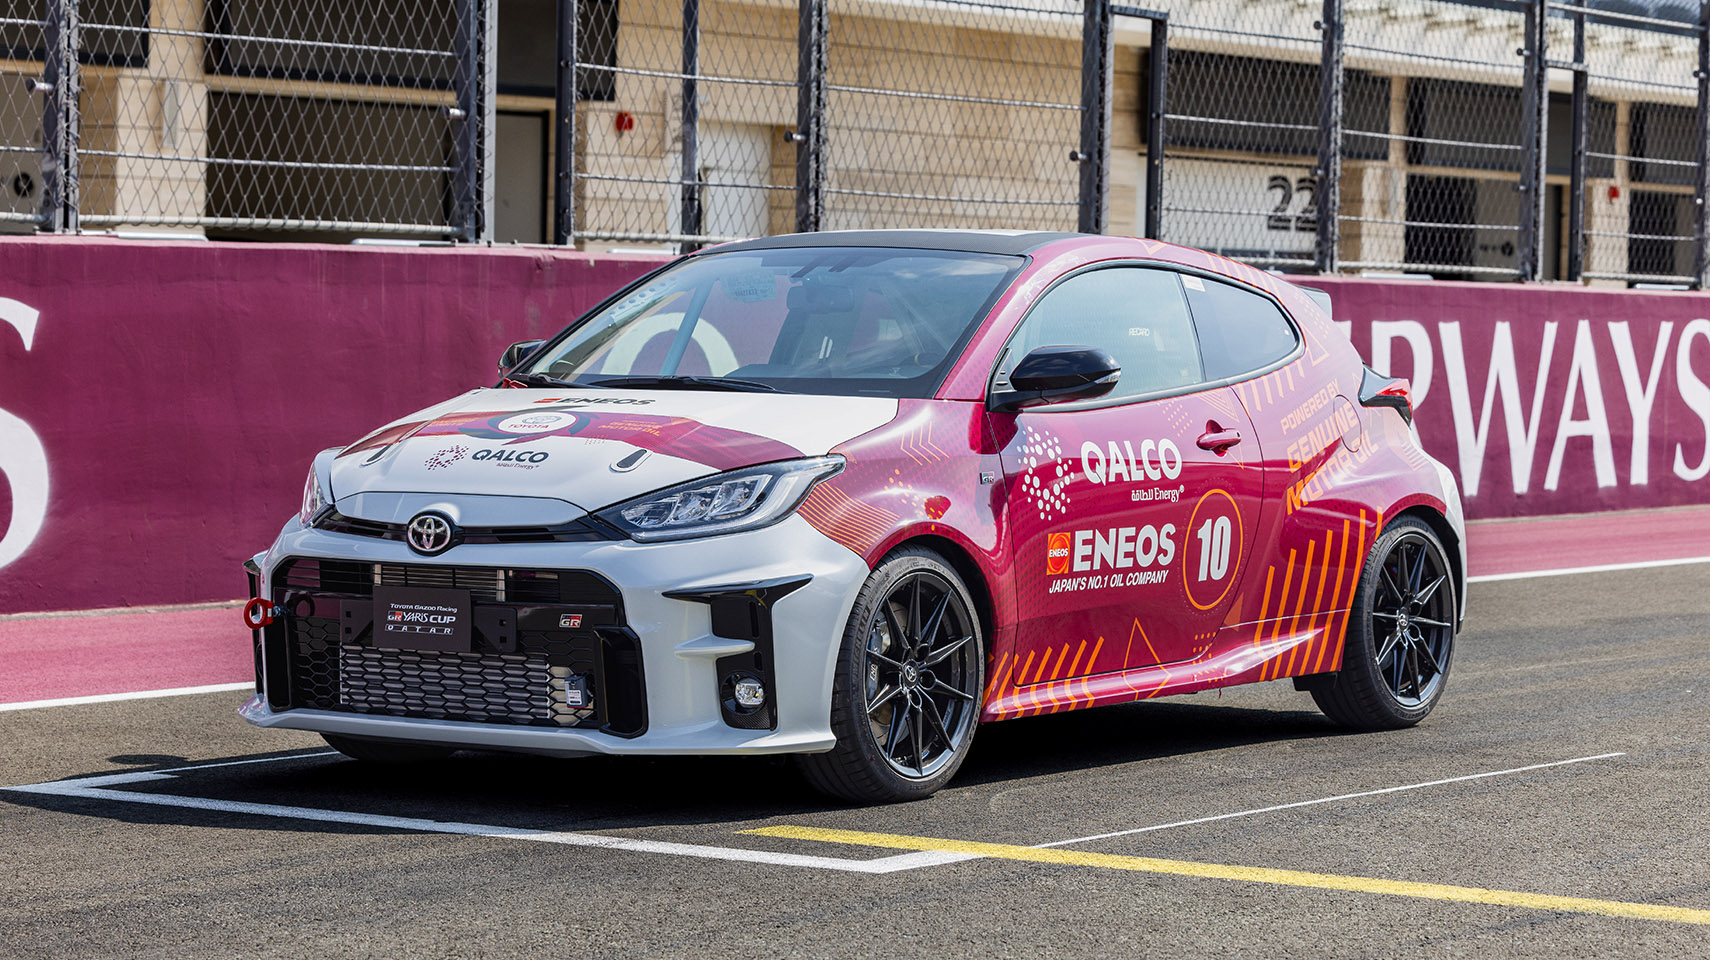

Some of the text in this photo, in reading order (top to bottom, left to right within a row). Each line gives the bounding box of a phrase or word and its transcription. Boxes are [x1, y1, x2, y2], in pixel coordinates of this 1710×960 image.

[1267, 176, 1317, 232] 22
[557, 397, 656, 405] ENEOS
[1280, 378, 1341, 435] POWERED BY
[1337, 319, 1710, 497] RWAYS
[471, 449, 549, 463] QALCO
[1286, 400, 1358, 473] GENUINE
[1080, 438, 1183, 486] QALCO
[1286, 430, 1379, 515] MOTOR OIL
[1049, 548, 1069, 558] ENEOS
[1072, 523, 1176, 572] ENEOS
[1197, 515, 1232, 582] 10
[1049, 569, 1169, 594] JAPAN'S NO.1 OIL COMPANY
[429, 615, 456, 624] CUP
